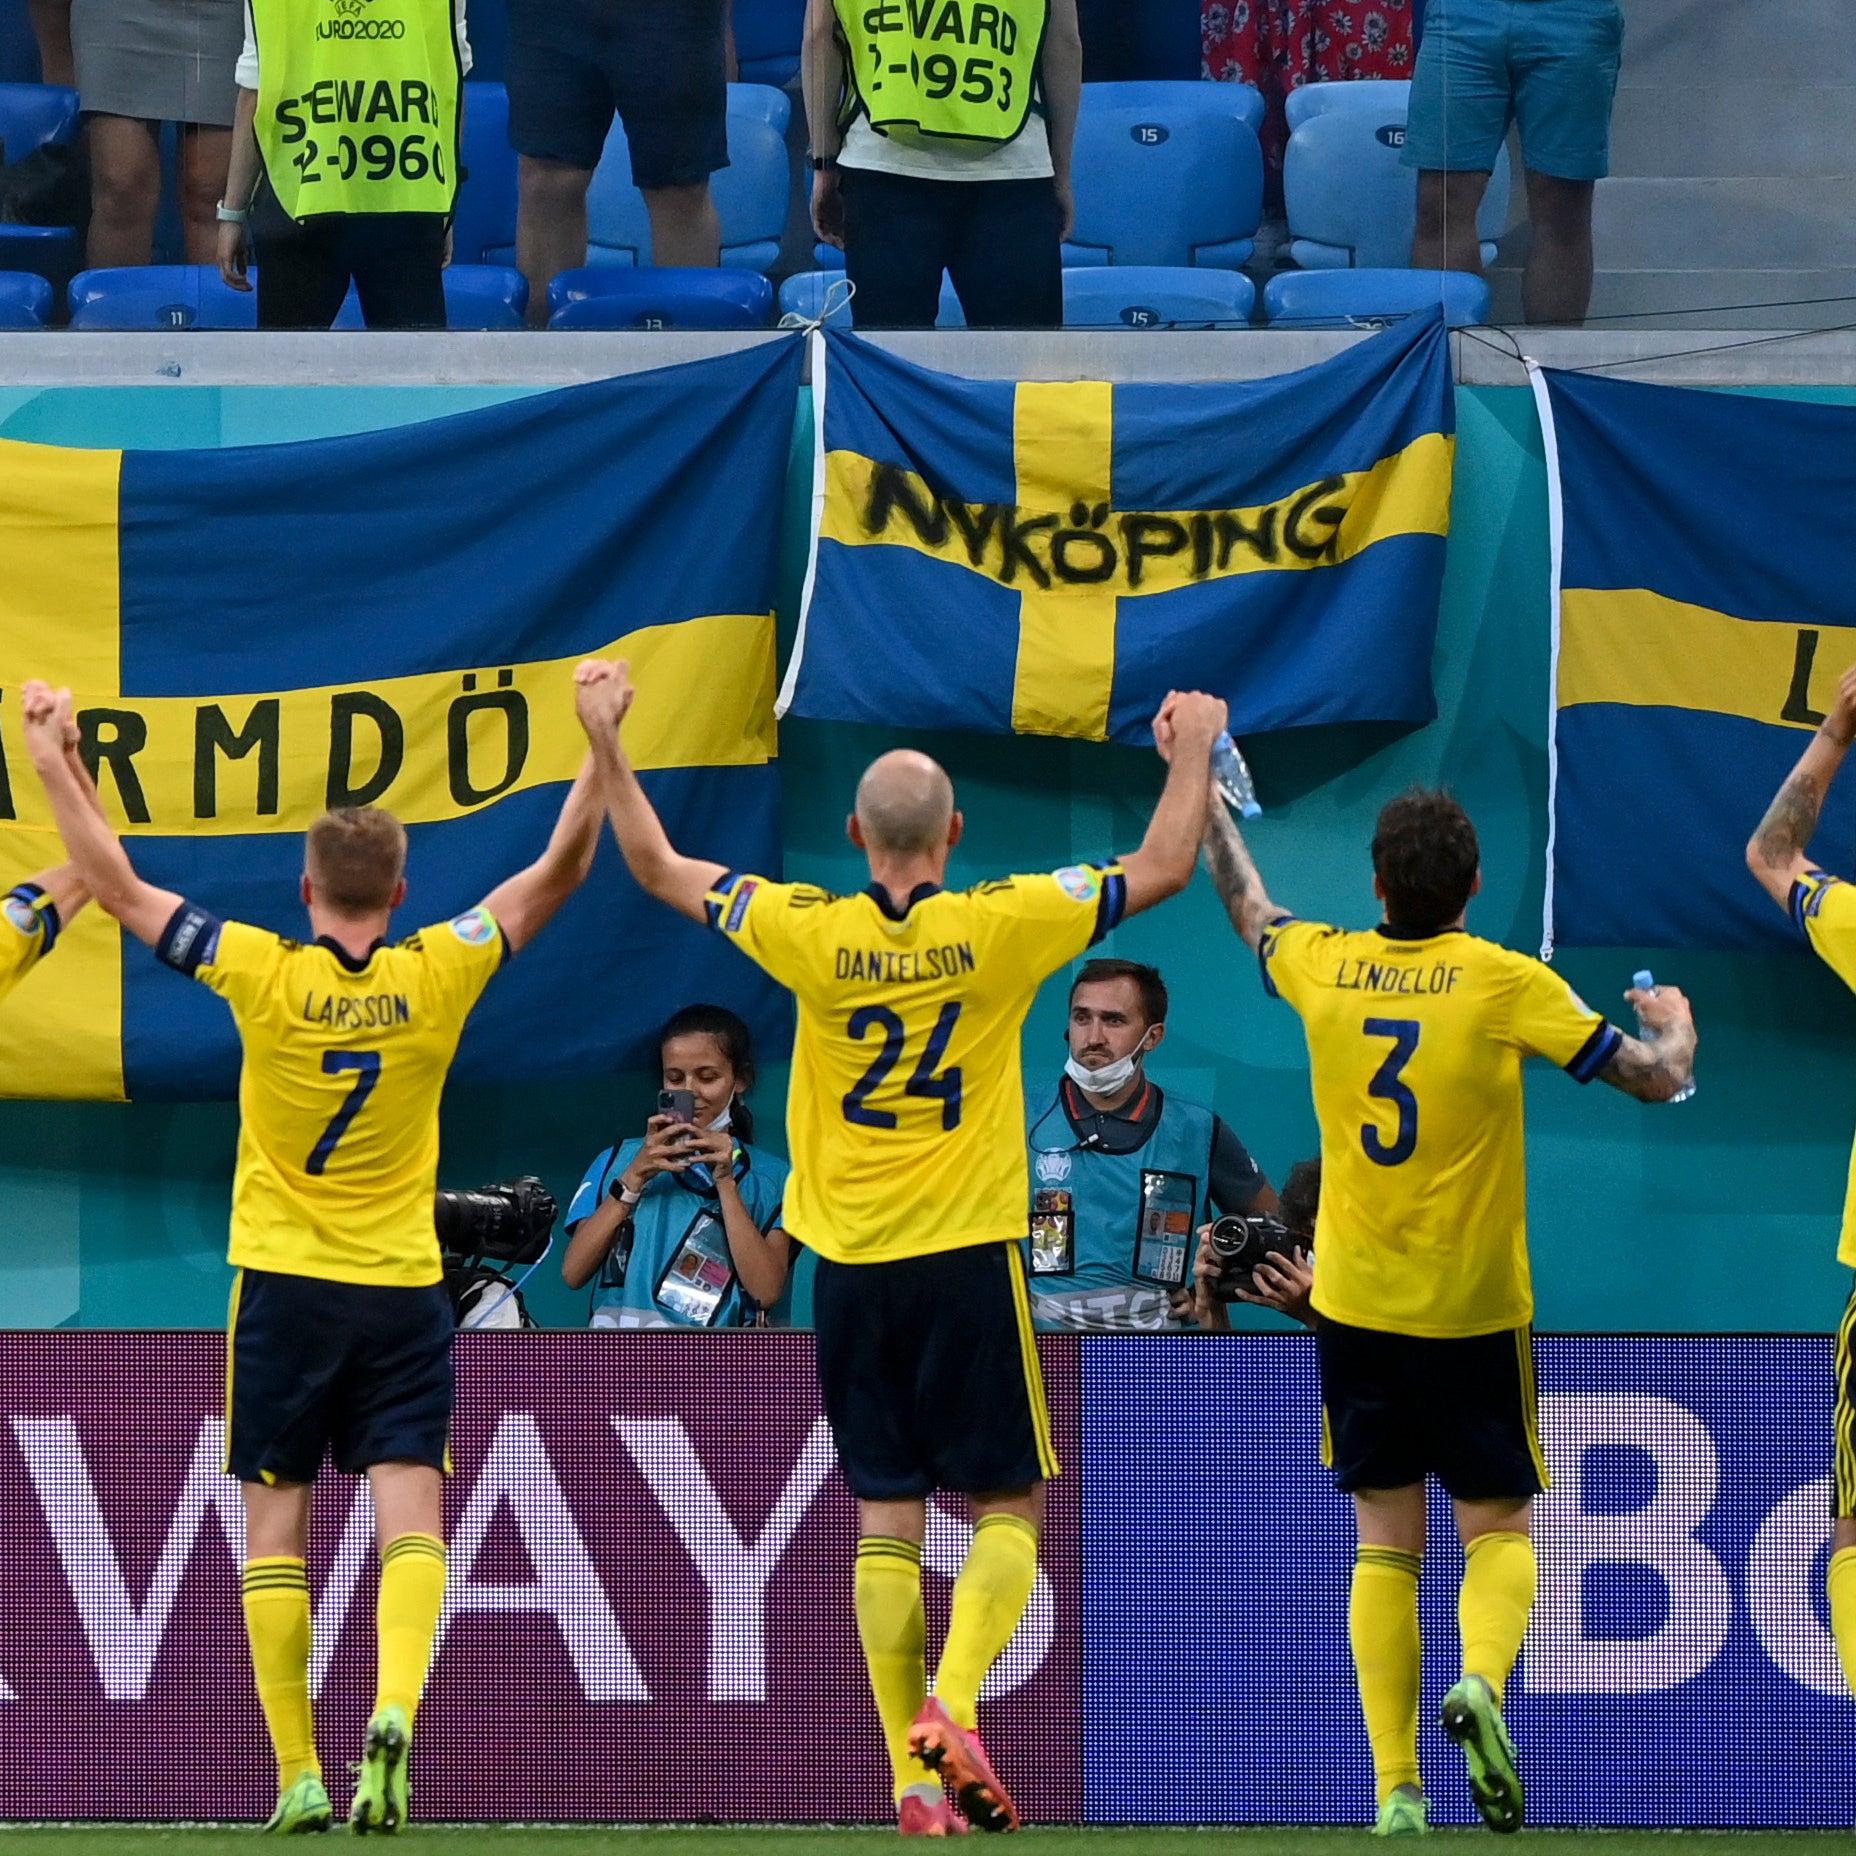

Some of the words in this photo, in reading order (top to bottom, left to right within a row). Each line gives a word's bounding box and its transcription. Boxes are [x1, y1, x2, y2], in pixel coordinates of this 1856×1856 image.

[869, 41, 1015, 112] 2-0953
[1142, 128, 1158, 143] 15
[1388, 129, 1405, 144] 16
[170, 311, 182, 325] 11
[1132, 311, 1148, 326] 15
[862, 463, 1348, 590] NYKÖPING
[835, 941, 976, 983] DANIELSON
[1334, 957, 1464, 995] LINDELÖF
[302, 989, 410, 1030] LARSSON
[842, 1001, 962, 1132] 24
[304, 1049, 382, 1176] 7
[1360, 1017, 1420, 1167] 3
